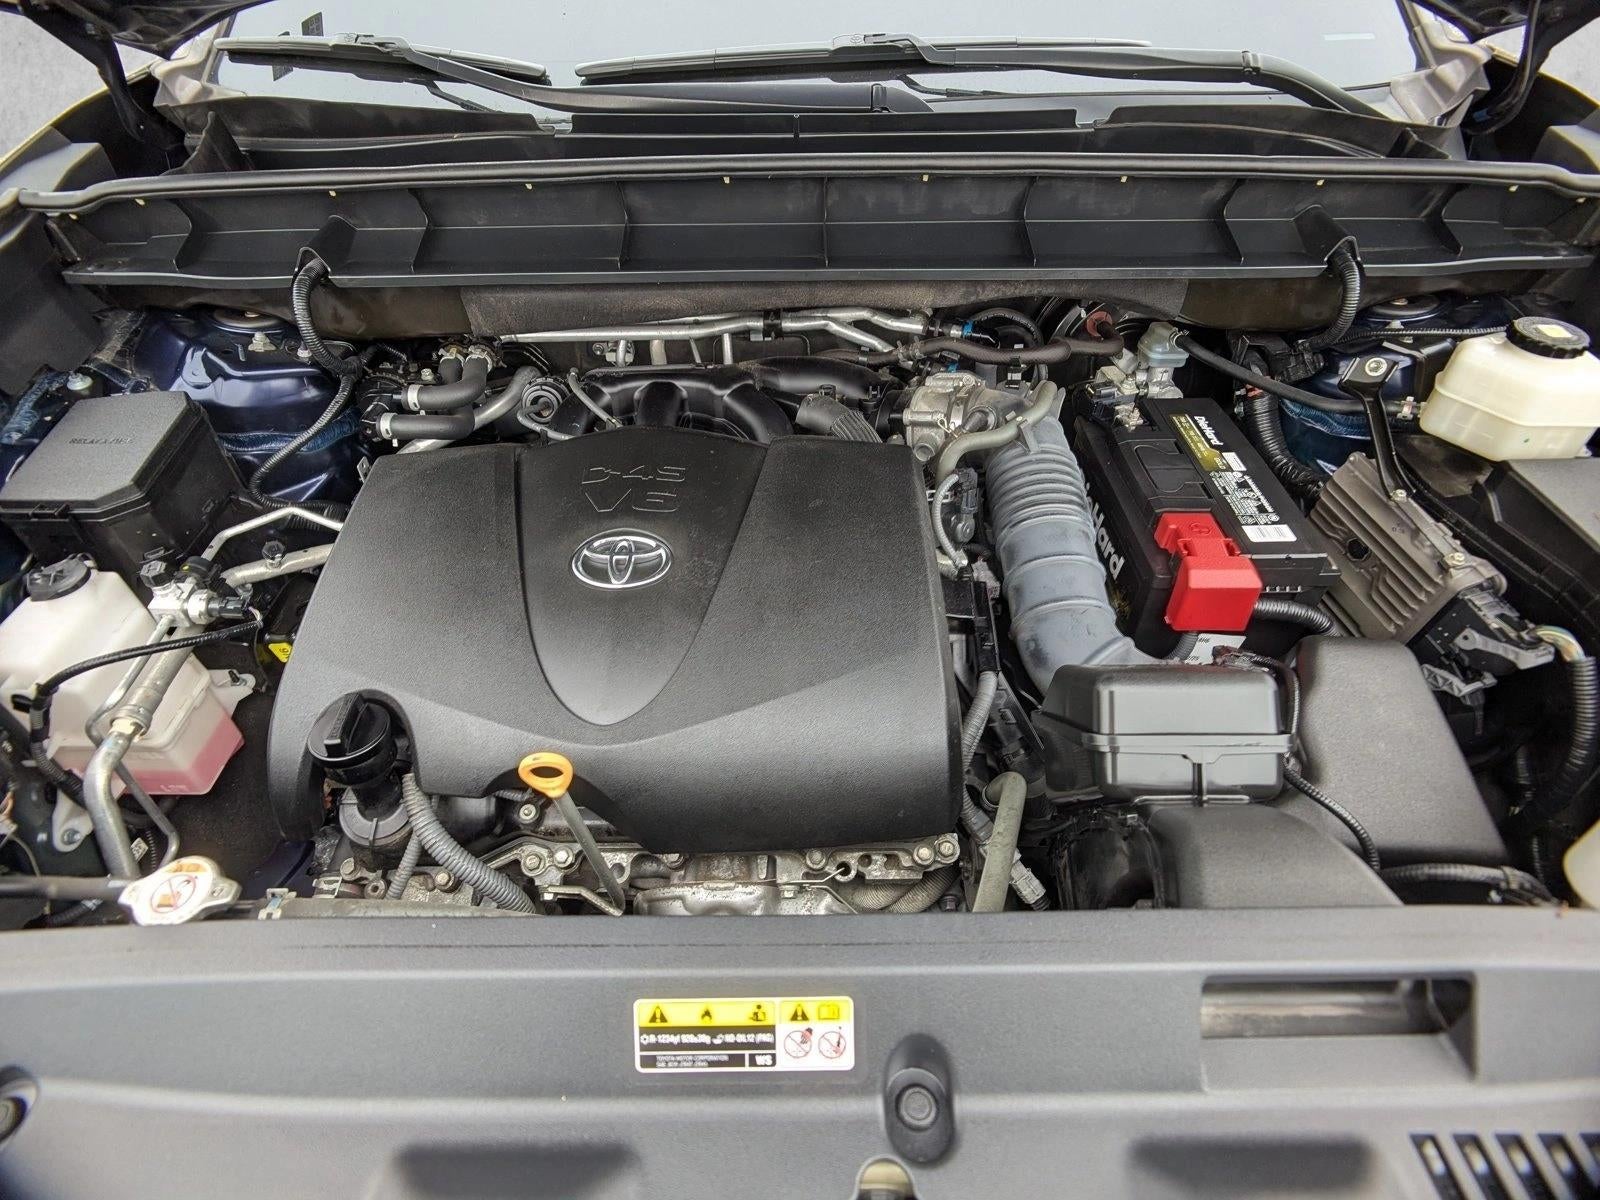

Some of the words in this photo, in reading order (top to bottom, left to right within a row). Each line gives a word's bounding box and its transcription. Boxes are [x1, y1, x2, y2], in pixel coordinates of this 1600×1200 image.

[1194, 416, 1224, 446] DieHard
[581, 465, 686, 484] D-4S
[584, 488, 679, 513] V6
